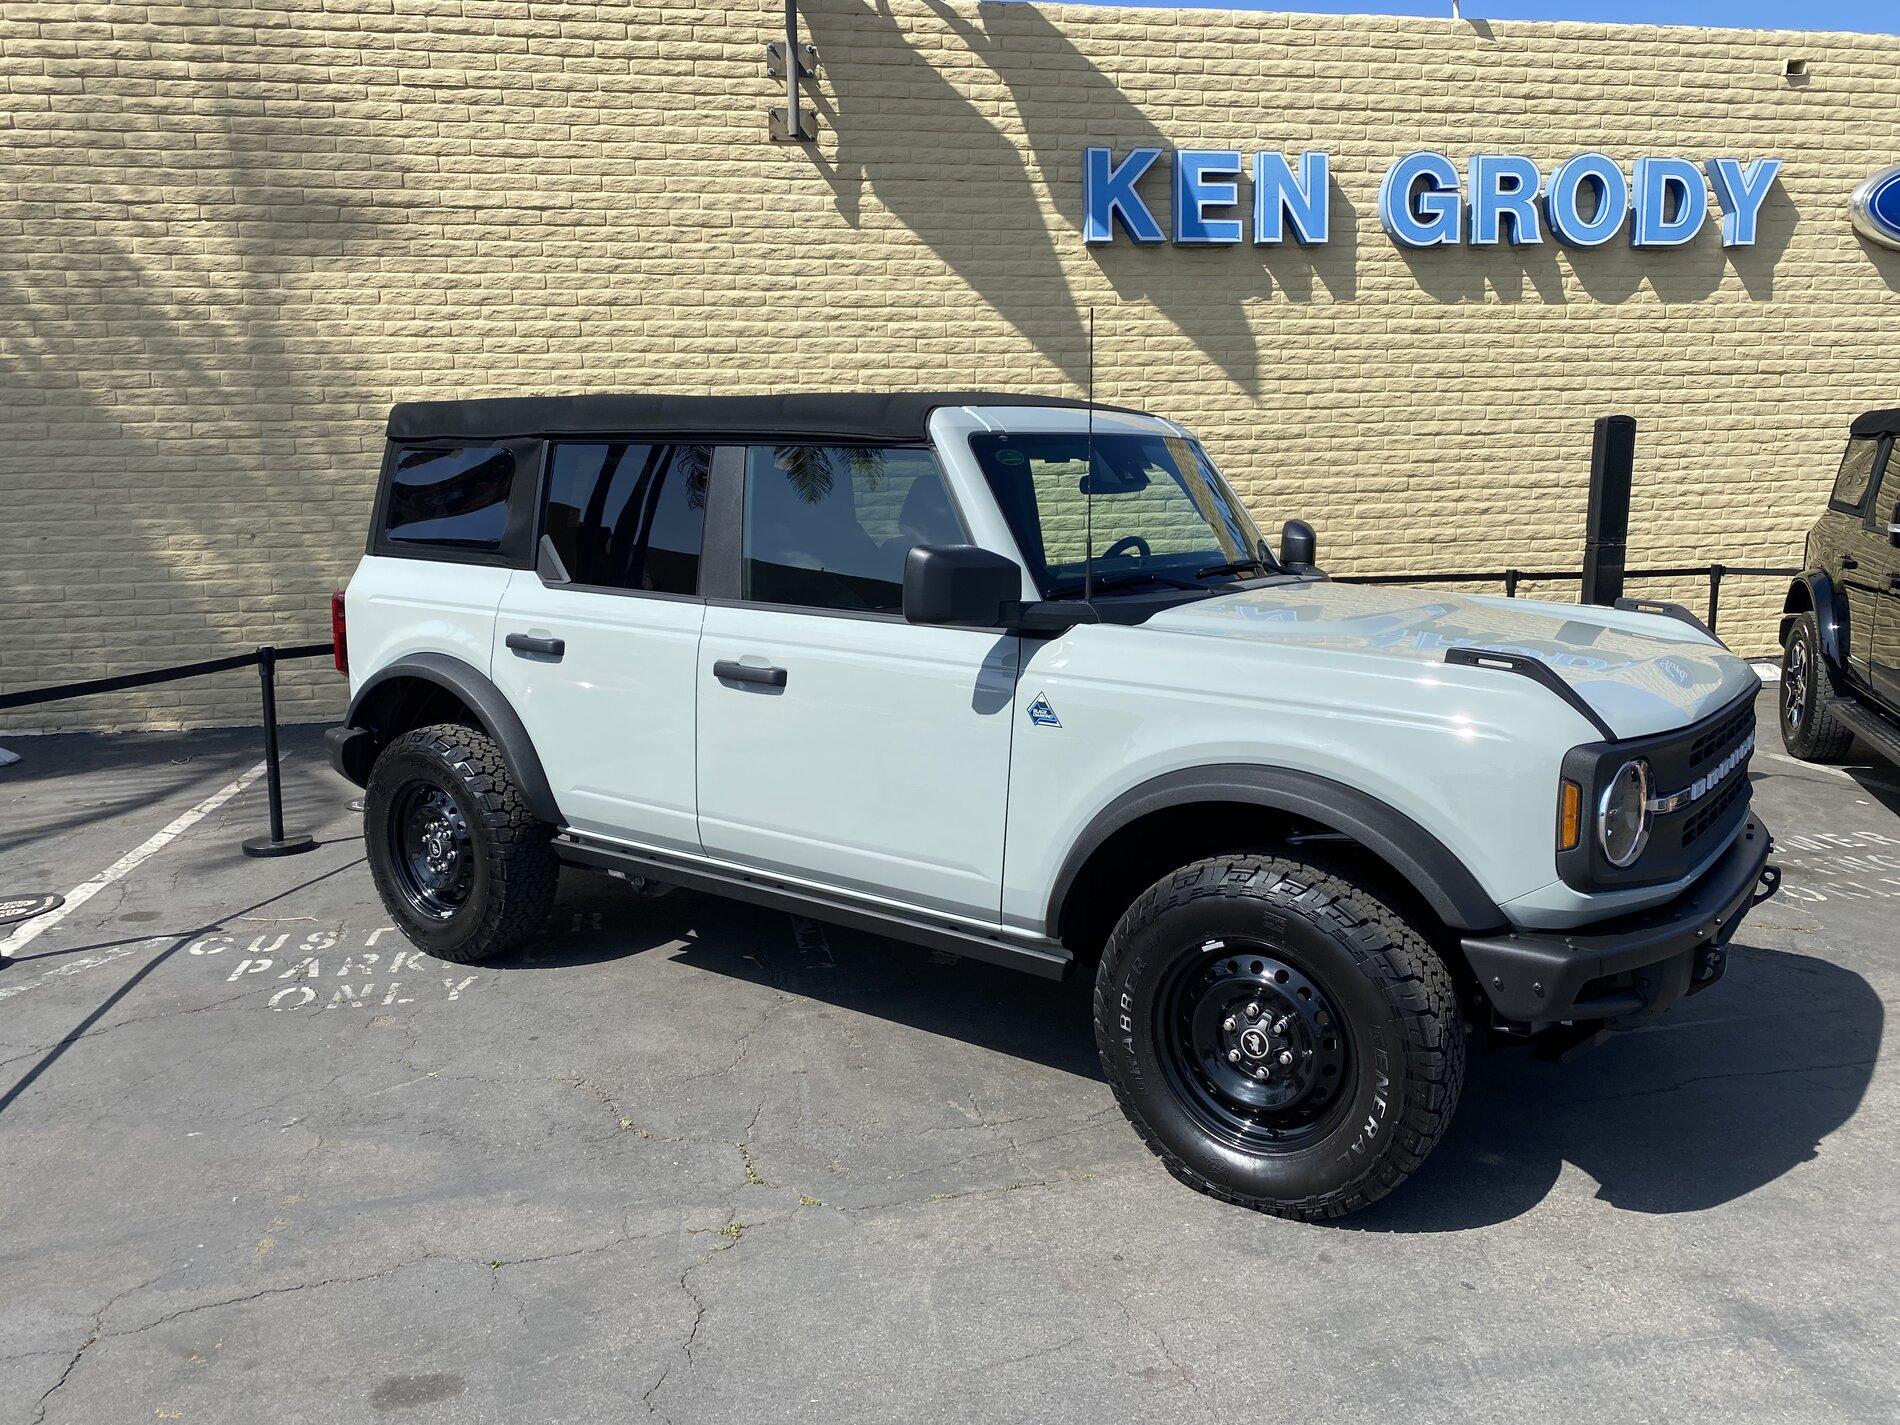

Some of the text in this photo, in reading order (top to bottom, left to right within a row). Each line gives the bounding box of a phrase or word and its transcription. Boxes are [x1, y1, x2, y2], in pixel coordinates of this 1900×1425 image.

[1082, 146, 1784, 248] KEN GRODY
[266, 975, 479, 1012] ONLY
